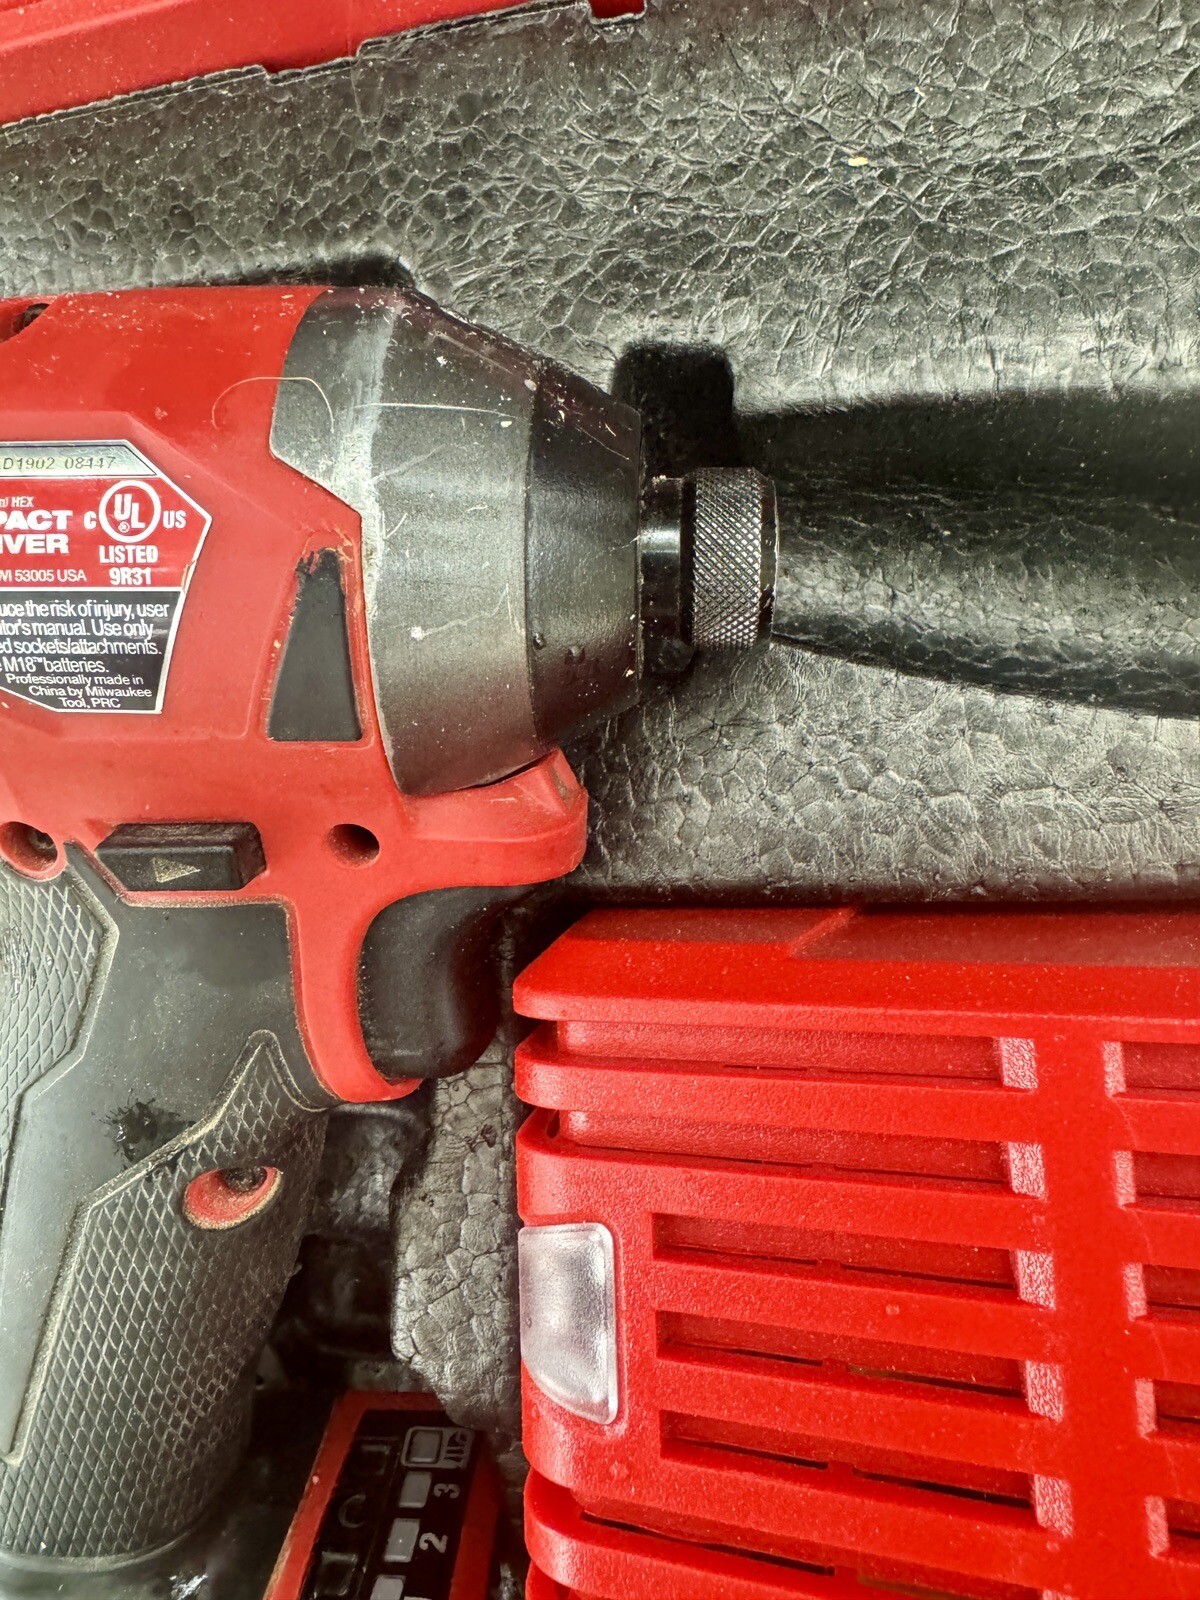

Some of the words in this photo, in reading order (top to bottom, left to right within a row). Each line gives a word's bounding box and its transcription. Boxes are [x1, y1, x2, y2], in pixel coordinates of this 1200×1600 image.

[11, 496, 34, 508] HEX
[114, 493, 146, 529] UL
[162, 510, 187, 529] US
[99, 545, 158, 564] LISTED
[15, 569, 55, 583] 53005
[57, 569, 87, 583] USA
[109, 566, 151, 586] 9R31
[25, 599, 50, 617] the
[50, 599, 77, 617] risk
[77, 599, 93, 617] of
[93, 599, 135, 621] injury,
[136, 603, 170, 618] user
[31, 618, 91, 636] manual.
[91, 618, 122, 636] Use
[123, 618, 154, 640] only
[43, 656, 110, 673] batteries.
[5, 673, 92, 687] Professionally
[93, 674, 131, 686] made
[131, 674, 144, 686] in
[28, 685, 66, 697] China
[67, 685, 84, 700] by
[85, 685, 153, 698] Milwaukee
[91, 697, 122, 709] PRC
[419, 1532, 449, 1554] 2
